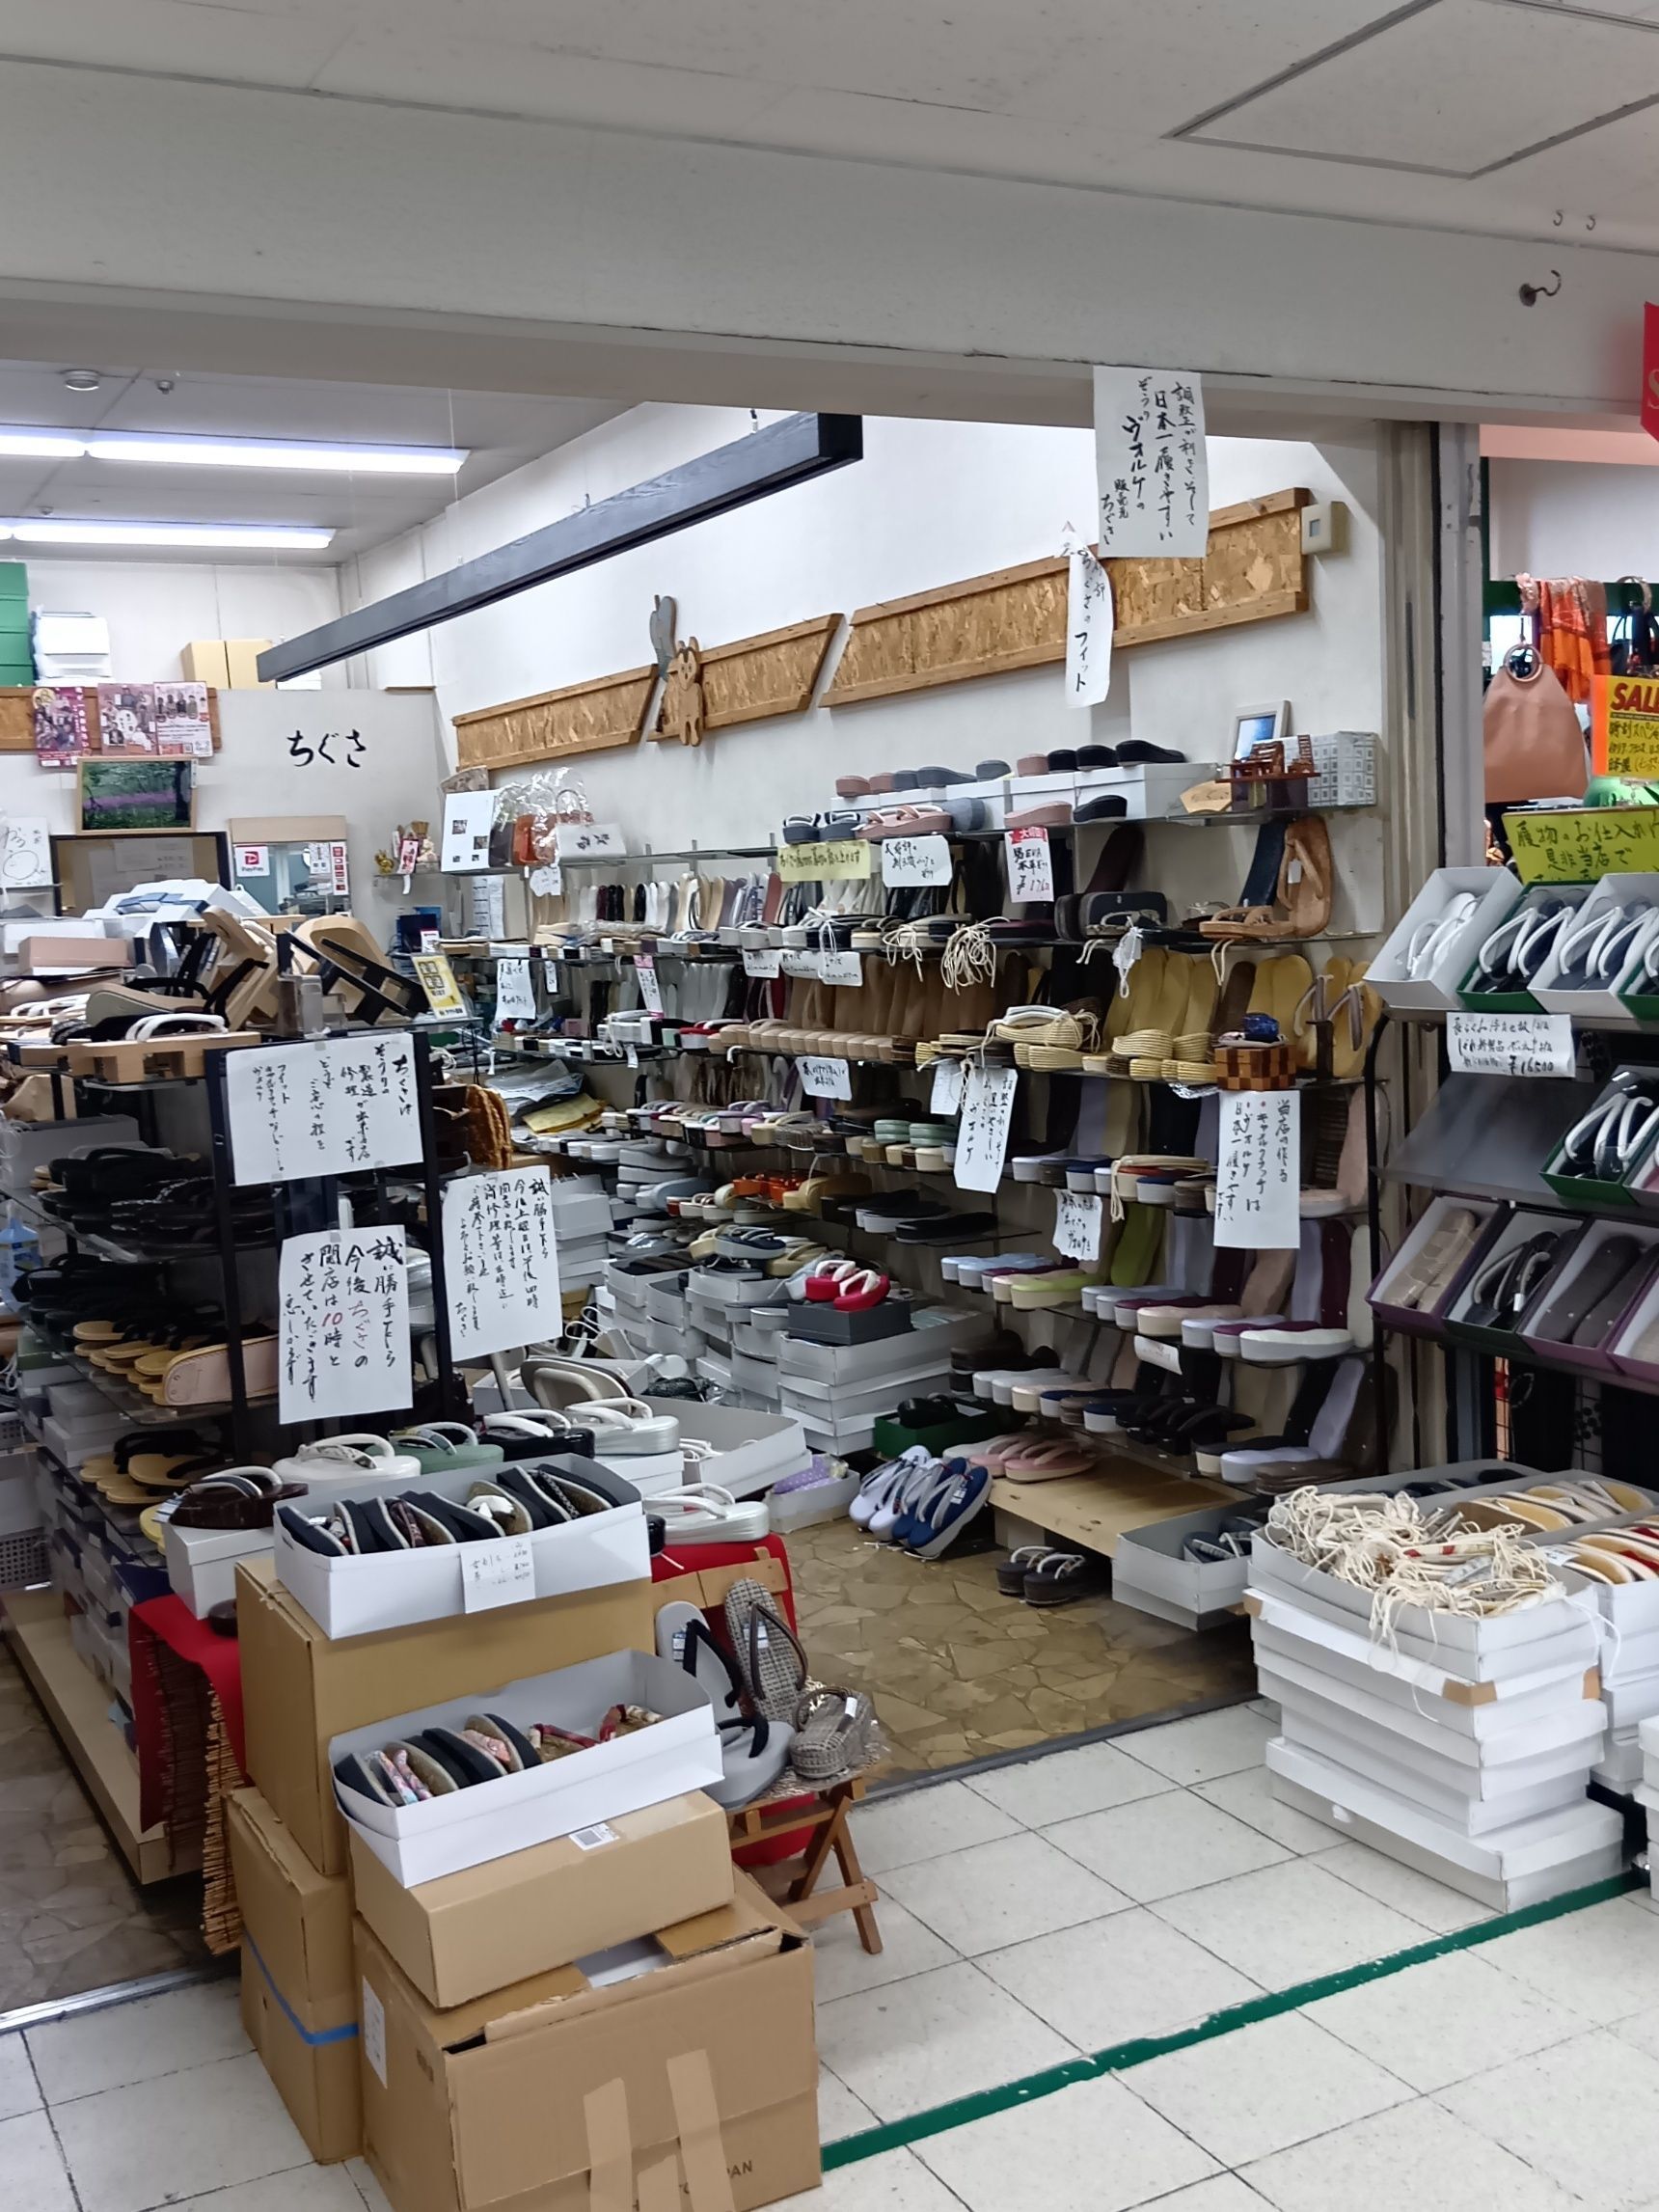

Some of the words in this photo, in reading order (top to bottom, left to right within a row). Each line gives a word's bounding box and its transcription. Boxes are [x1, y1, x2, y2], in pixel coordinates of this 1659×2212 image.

[1610, 682, 1659, 714] SAL
[286, 728, 367, 768] ちぐさ
[1545, 841, 1633, 872] 是非当店で
